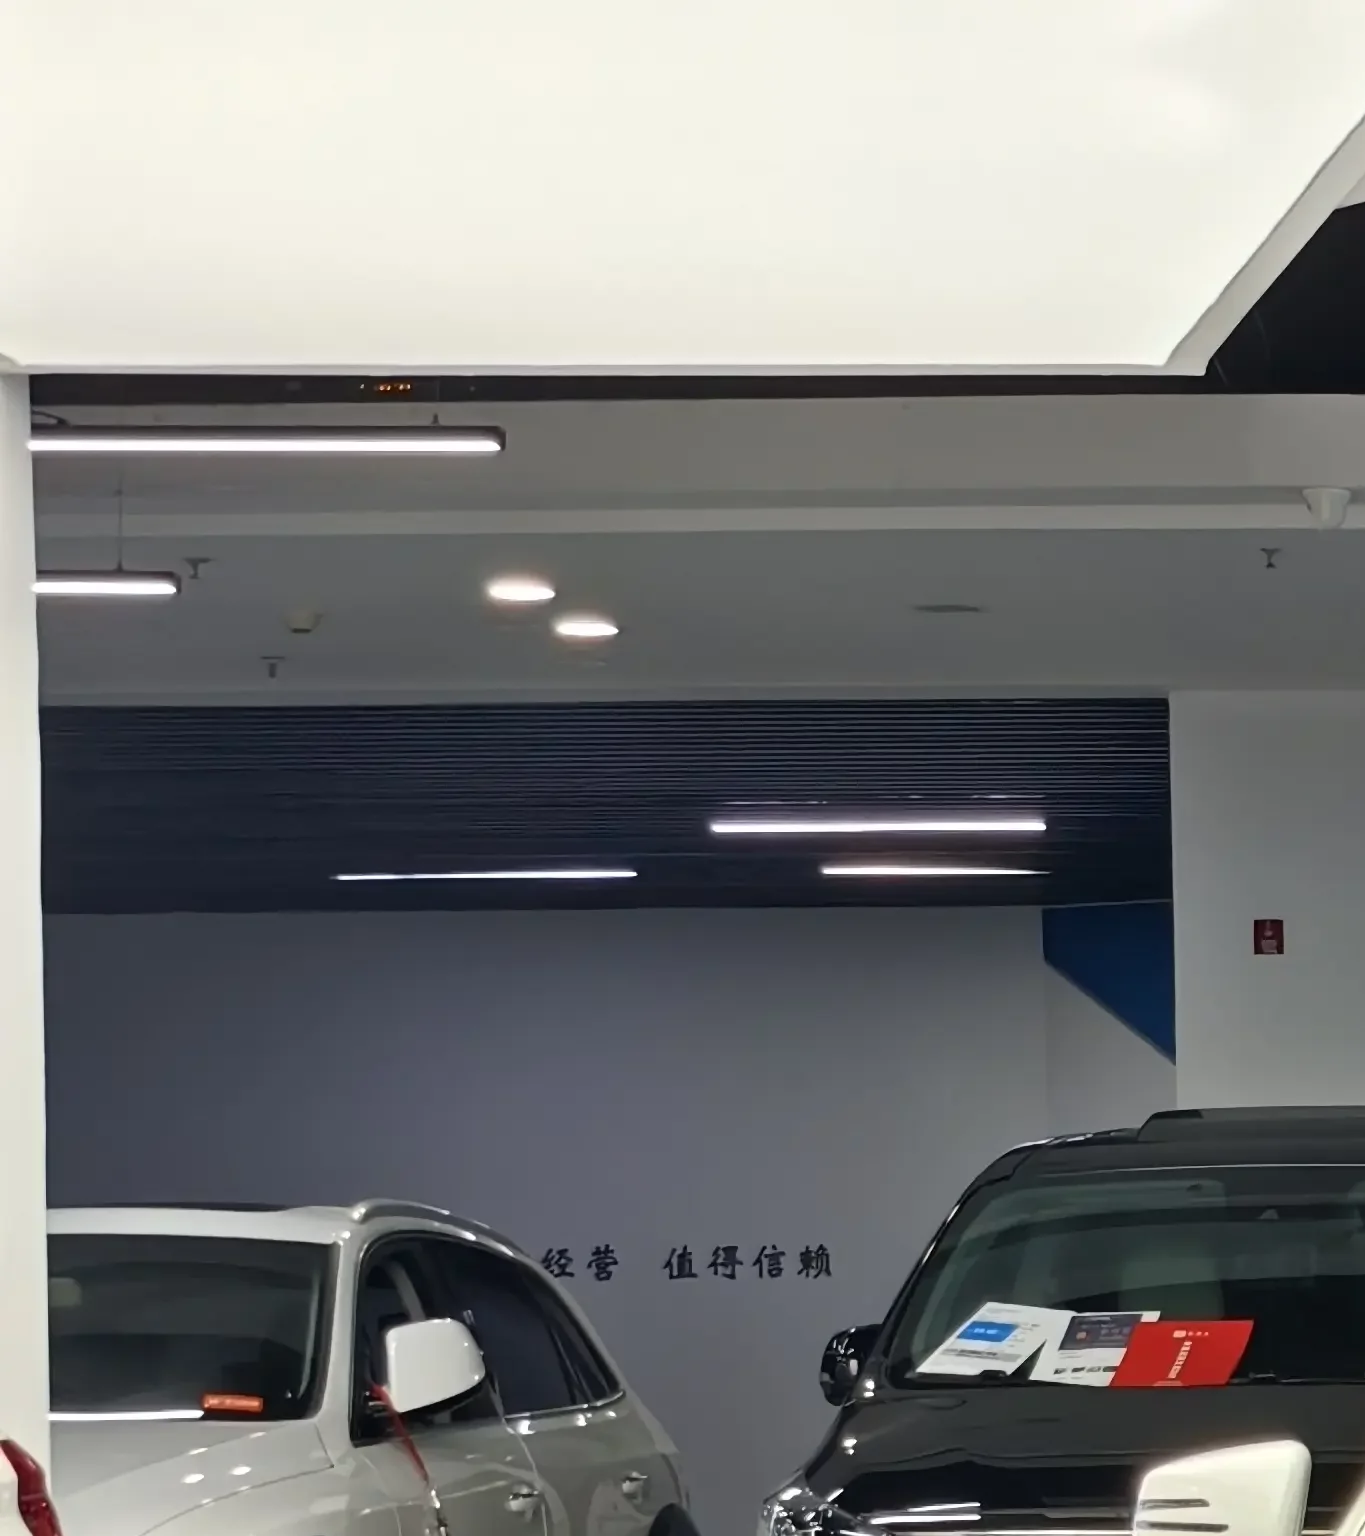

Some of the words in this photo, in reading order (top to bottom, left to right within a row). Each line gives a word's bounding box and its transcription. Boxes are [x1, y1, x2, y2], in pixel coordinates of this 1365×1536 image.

[541, 1244, 619, 1281] 经营
[662, 1244, 833, 1280] 值得信赖
